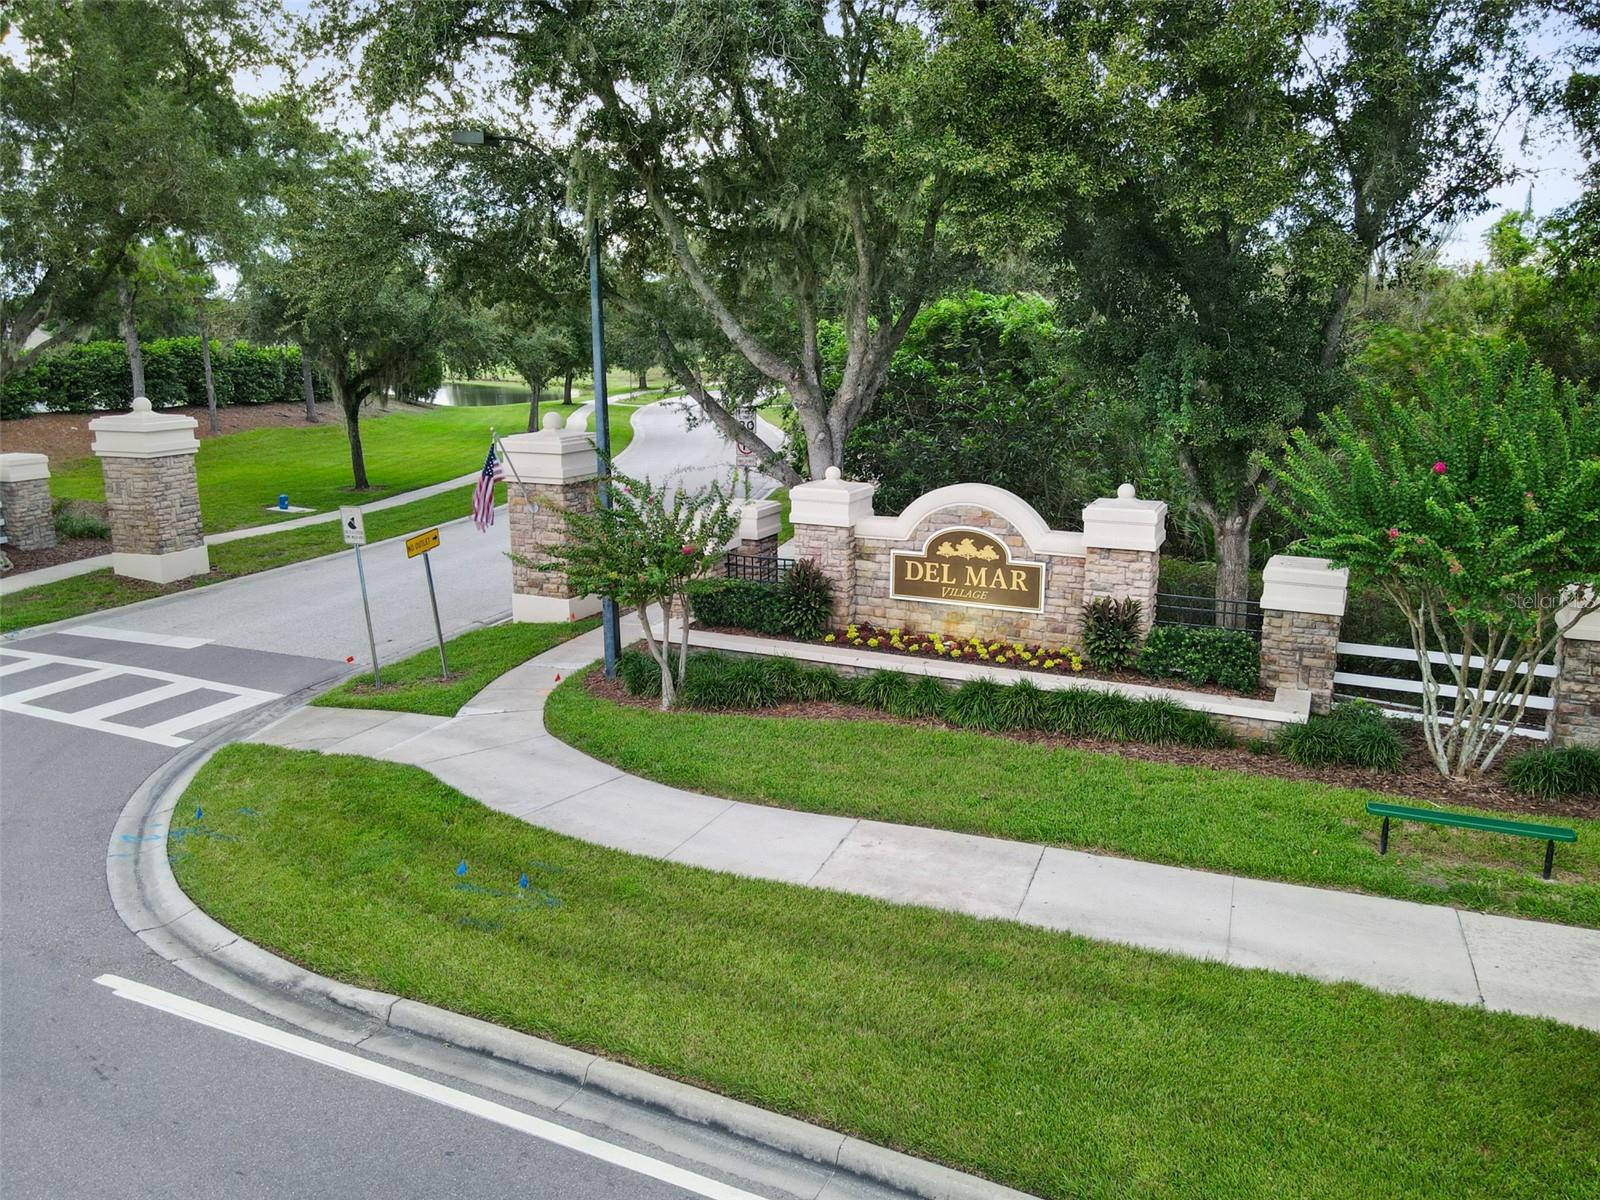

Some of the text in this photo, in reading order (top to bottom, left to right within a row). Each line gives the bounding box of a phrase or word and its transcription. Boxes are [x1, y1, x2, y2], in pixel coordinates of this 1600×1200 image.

[904, 560, 1028, 592] DEL MAR
[941, 586, 989, 600] VILLAGE
